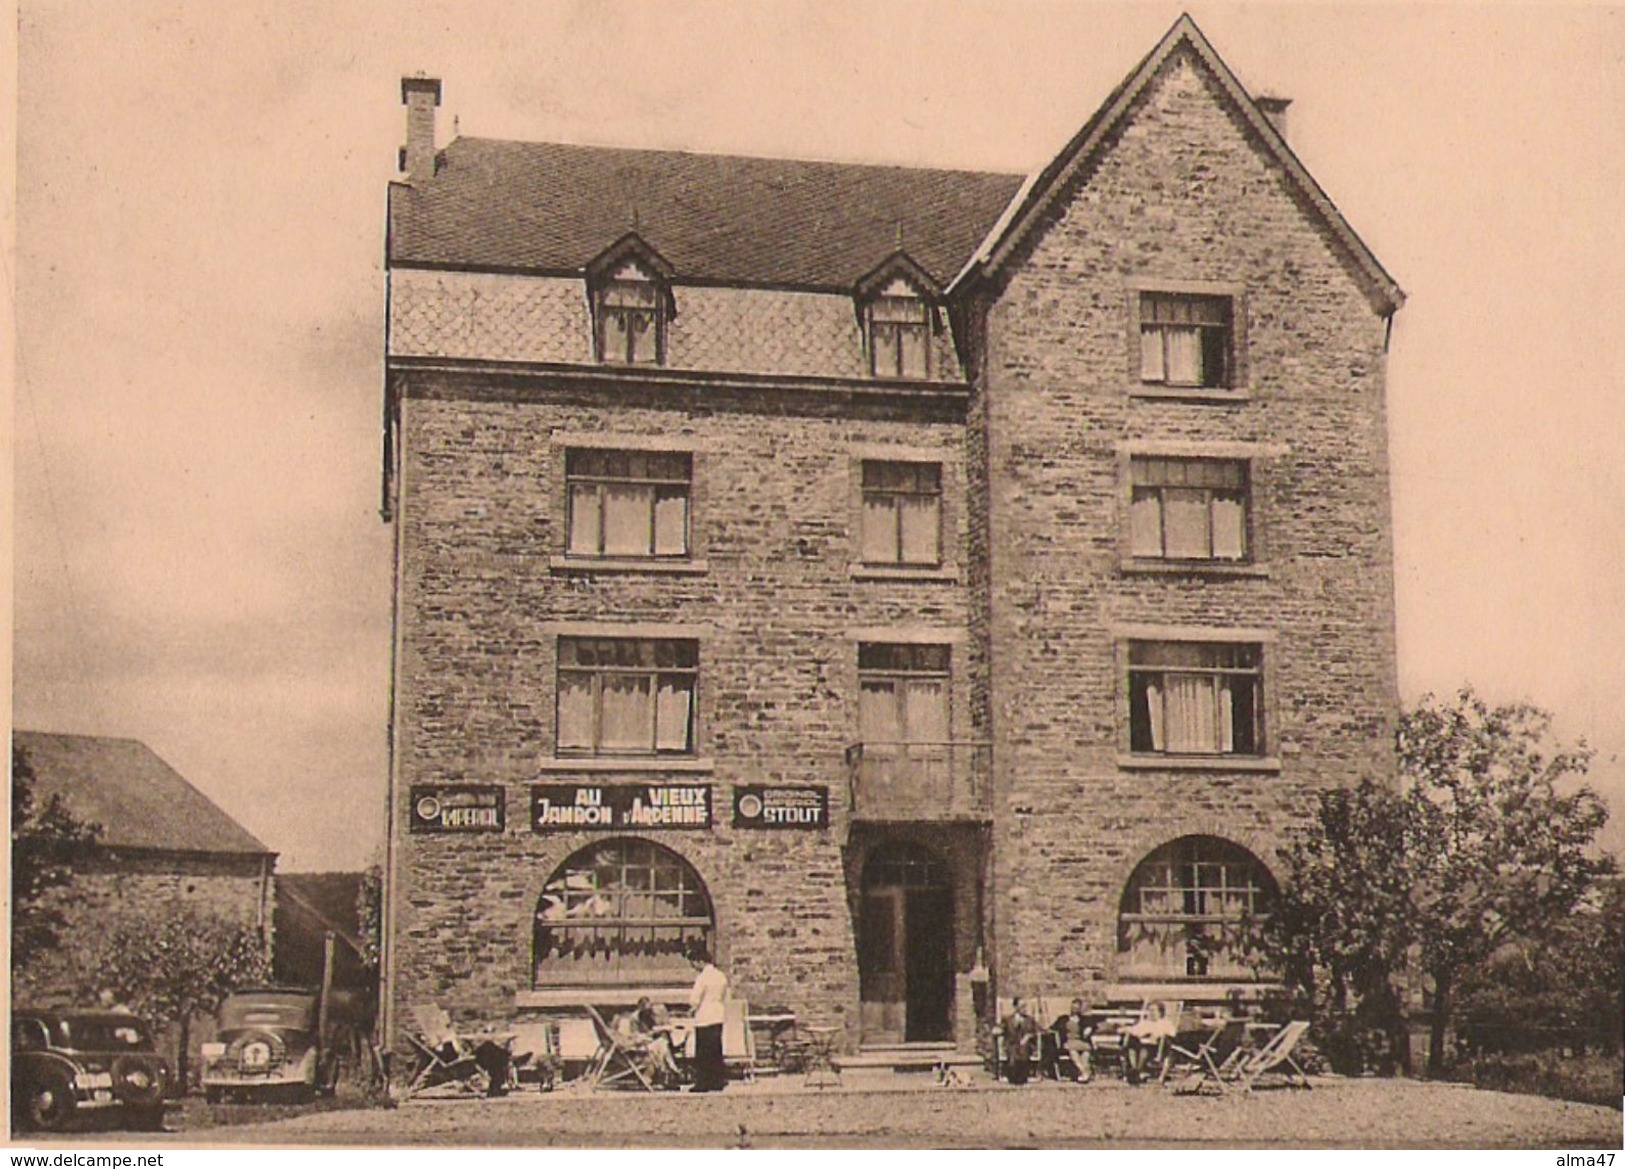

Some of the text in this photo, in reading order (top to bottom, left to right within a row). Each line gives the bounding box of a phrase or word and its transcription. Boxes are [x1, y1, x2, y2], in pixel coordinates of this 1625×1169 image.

[576, 788, 707, 805] AU VIEUX
[764, 807, 822, 823] STOUT
